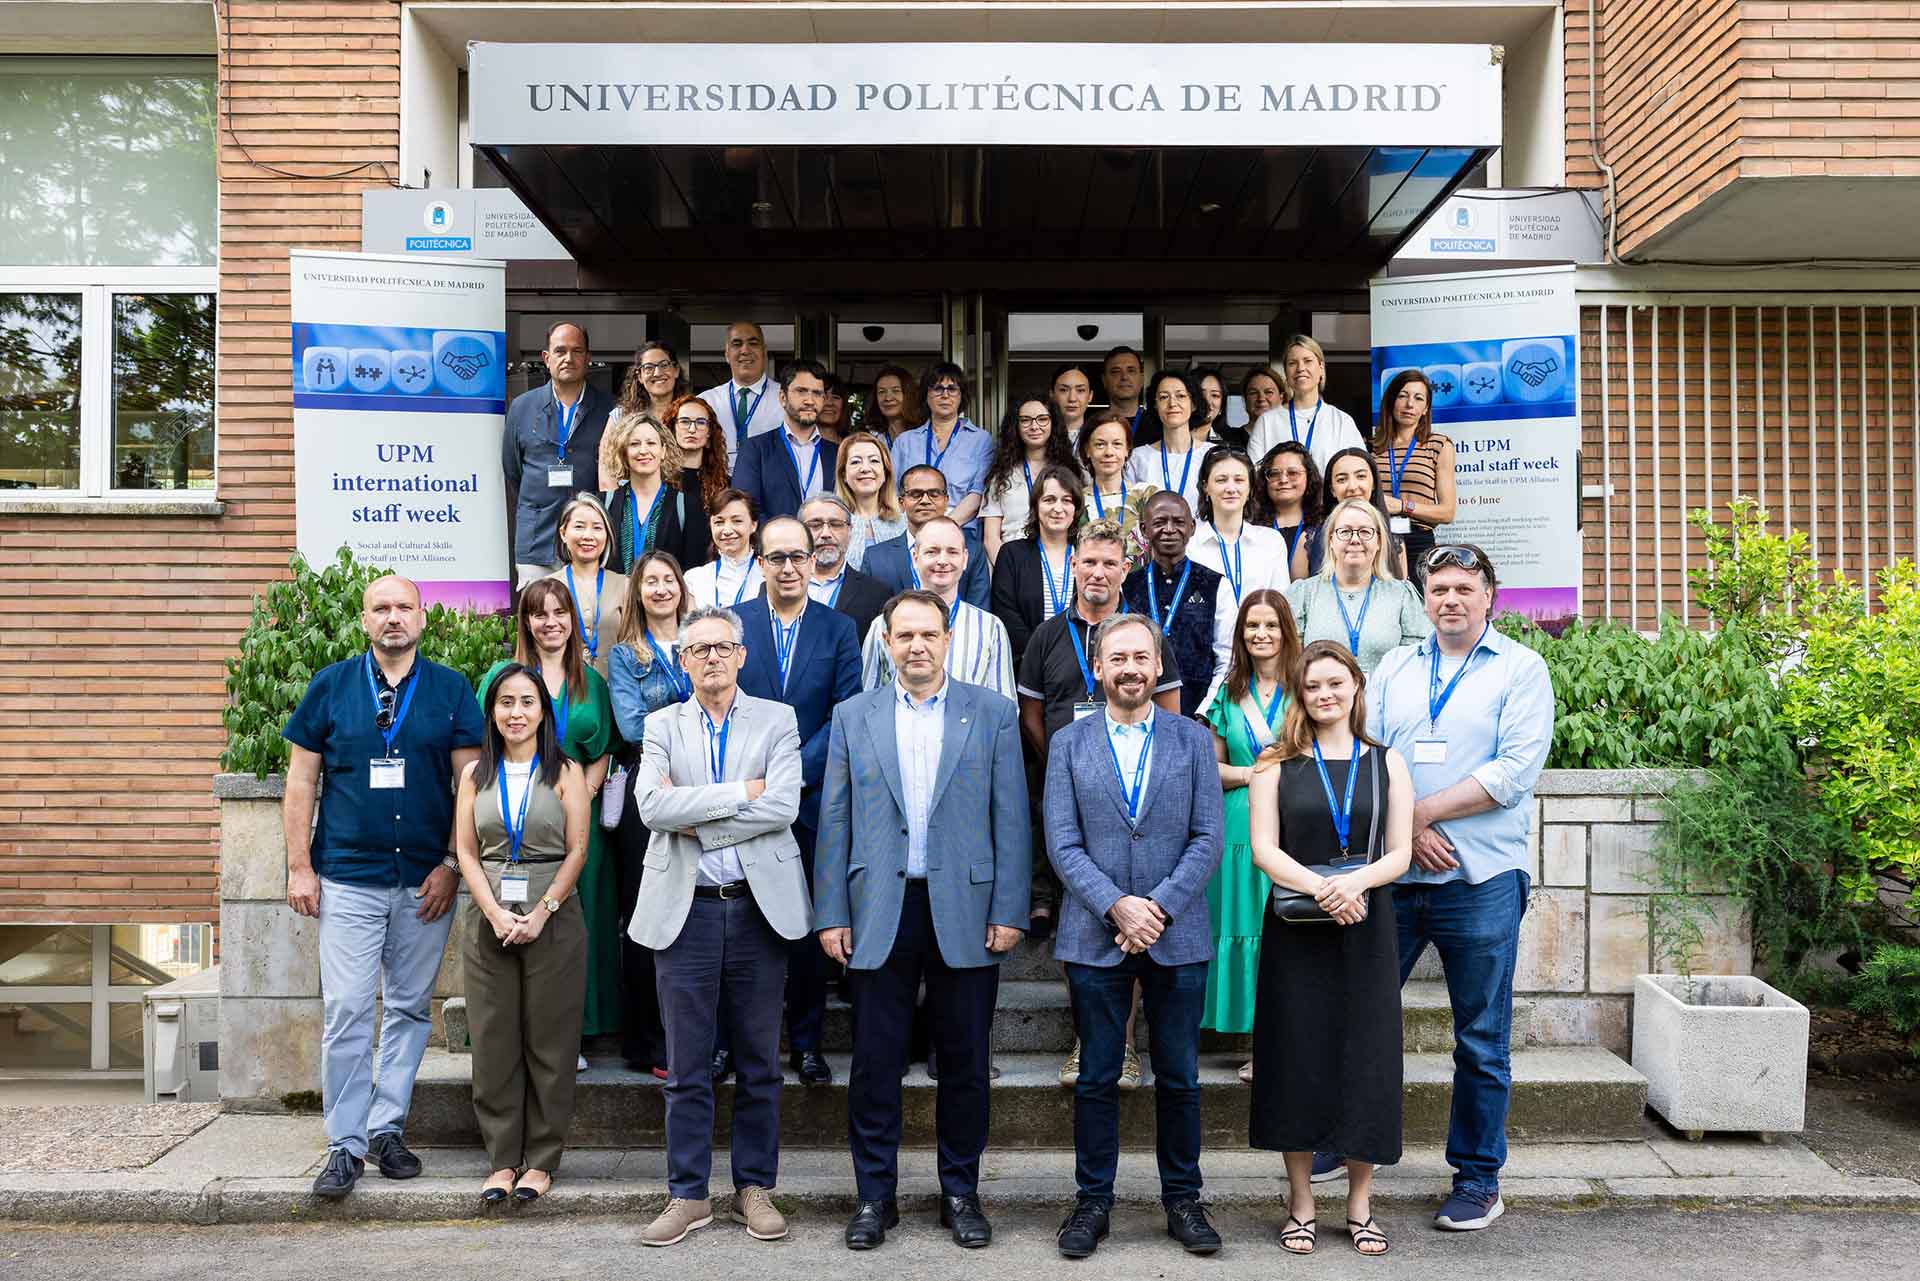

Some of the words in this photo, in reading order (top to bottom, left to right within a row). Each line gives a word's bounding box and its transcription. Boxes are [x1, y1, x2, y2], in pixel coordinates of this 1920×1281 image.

[526, 83, 837, 112] UNIVERSIDAD
[855, 75, 1165, 112] POLITÉCNICA
[1180, 84, 1242, 112] DE
[1260, 83, 1441, 112] MADRID
[303, 272, 368, 284] UNIVERSIDAD
[433, 280, 448, 288] DE
[448, 280, 485, 290] MADRID
[1381, 295, 1441, 307] UNIVERSIDAD
[1503, 290, 1515, 298] DE
[1516, 288, 1554, 298] MADRID
[376, 443, 434, 463] UPM
[1455, 440, 1469, 453] th
[1474, 439, 1511, 453] UPM
[1488, 457, 1521, 472] staff
[1523, 456, 1560, 470] week
[332, 472, 479, 493] international
[1458, 496, 1468, 505] to
[1470, 496, 1477, 504] 6
[1479, 495, 1501, 505] June
[352, 503, 402, 522] staff
[406, 503, 462, 523] week
[358, 540, 380, 549] Social
[383, 540, 397, 549] and
[400, 540, 431, 549] Cultural
[432, 540, 453, 549] Skills
[357, 553, 368, 561] for
[370, 553, 387, 561] Staff
[399, 553, 420, 561] UPM
[422, 553, 456, 561] Alliances
